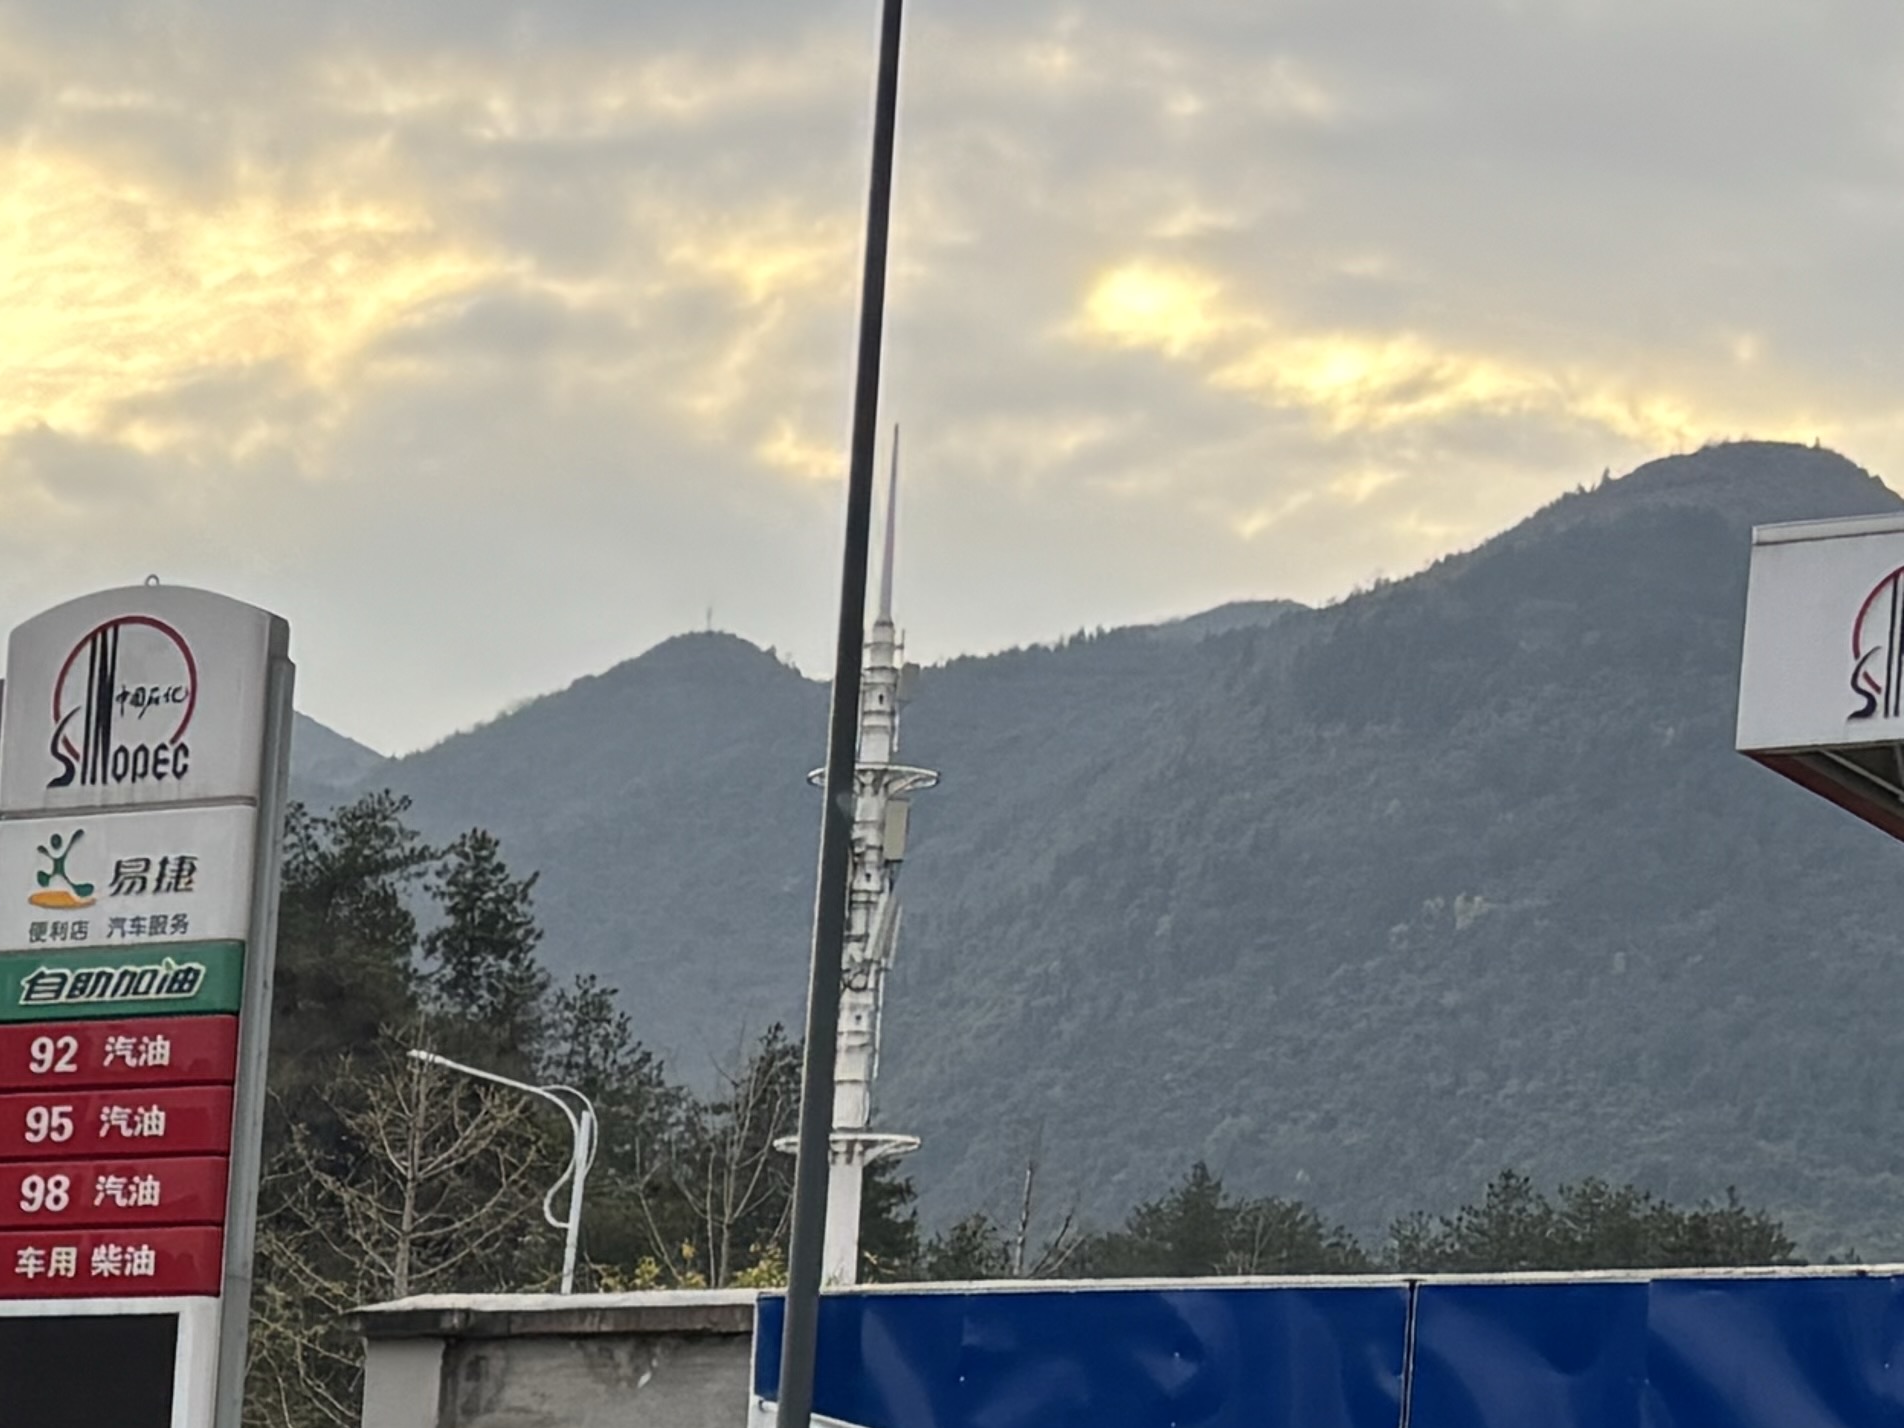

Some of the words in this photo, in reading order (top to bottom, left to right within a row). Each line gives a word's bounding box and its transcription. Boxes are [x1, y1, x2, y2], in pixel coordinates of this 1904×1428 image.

[46, 622, 190, 789] SINOPEC
[116, 685, 187, 719] 中国石化
[108, 855, 198, 897] 易捷
[28, 920, 89, 944] 便利店
[106, 913, 190, 939] 汽车服务
[20, 958, 206, 1005] 自助加油
[28, 1036, 79, 1073] 92
[103, 1034, 171, 1067] 汽油
[24, 1106, 74, 1143] 95
[99, 1105, 166, 1137] 汽油
[19, 1174, 70, 1213] 98
[94, 1174, 161, 1207] 汽油
[14, 1246, 78, 1279] 车用
[90, 1244, 156, 1277] 柴油
